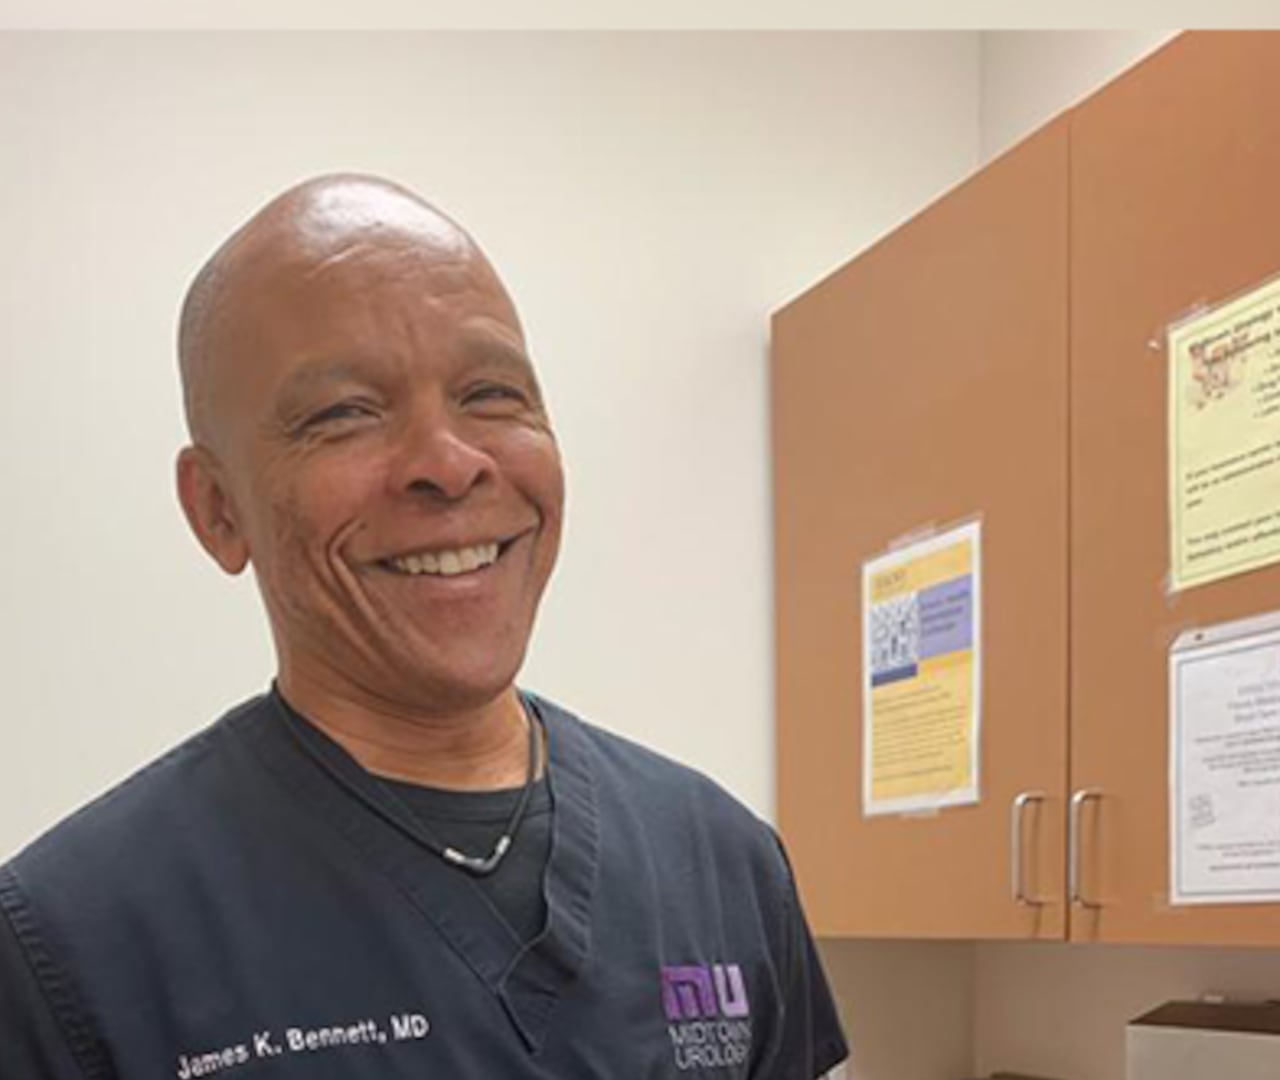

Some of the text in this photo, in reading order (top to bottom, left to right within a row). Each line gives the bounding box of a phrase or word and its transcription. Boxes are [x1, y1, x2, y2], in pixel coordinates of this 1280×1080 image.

[176, 1013, 429, 1080] James K. Bennett, MD
[674, 1043, 748, 1070] UROLOGY
